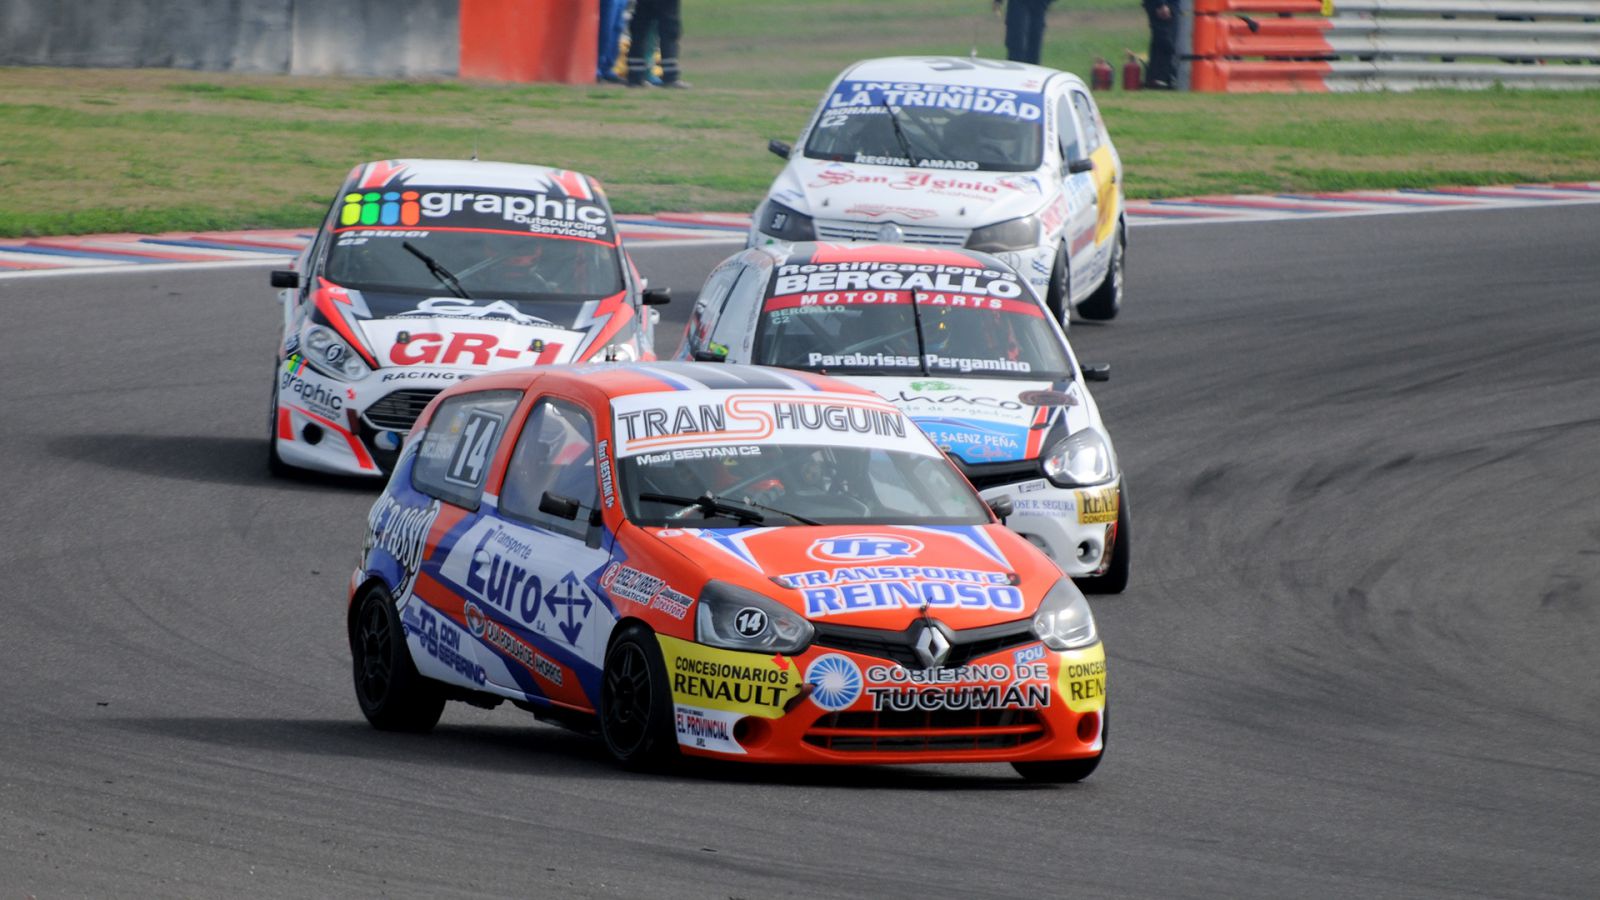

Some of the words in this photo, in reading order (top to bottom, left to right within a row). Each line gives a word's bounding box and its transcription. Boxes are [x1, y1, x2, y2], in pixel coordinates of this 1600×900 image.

[852, 82, 1018, 100] INGENIO
[830, 92, 873, 109] LA
[883, 91, 1041, 121] TRINIDAD
[820, 115, 848, 128] C2
[918, 157, 979, 170] AMADO
[420, 191, 606, 224] graphic
[514, 214, 606, 235] Outsourcing
[530, 223, 597, 239] Services
[778, 262, 1017, 281] Rectificaciones
[774, 272, 1022, 299] BERGALLO
[770, 304, 846, 317] BERGALLO
[800, 291, 898, 304] MOTOR
[916, 292, 1004, 309] PARTS
[771, 315, 790, 325] C2
[389, 332, 565, 366] GR-1
[808, 352, 920, 367] Parabrisas
[925, 354, 1031, 373] Pergamino
[382, 371, 455, 383] RACING
[280, 371, 343, 410] graphic
[454, 416, 497, 481] 14
[940, 432, 982, 444] SAENZ
[984, 434, 1019, 449] PEÑA
[636, 452, 671, 466] Maxi
[673, 447, 738, 460] BESTANI
[740, 446, 761, 455] C2
[600, 460, 613, 497] BESTANI
[1042, 499, 1075, 511] SEGURA
[493, 525, 533, 560] Transporte
[466, 528, 542, 624] Euro
[784, 568, 1007, 590] TRANSPORTE
[805, 582, 1025, 616] REINOSO
[739, 612, 763, 630] 14
[440, 621, 461, 651] DON
[1016, 647, 1042, 663] POU
[675, 656, 789, 685] CONCESIONARIOS
[868, 665, 1010, 684] GOBIERNO
[1016, 664, 1048, 680] DE
[674, 673, 788, 707] RENAULT
[868, 681, 1051, 711] TUCUMÁN
[676, 713, 686, 733] EL
[687, 715, 729, 740] PROVINCIAL
